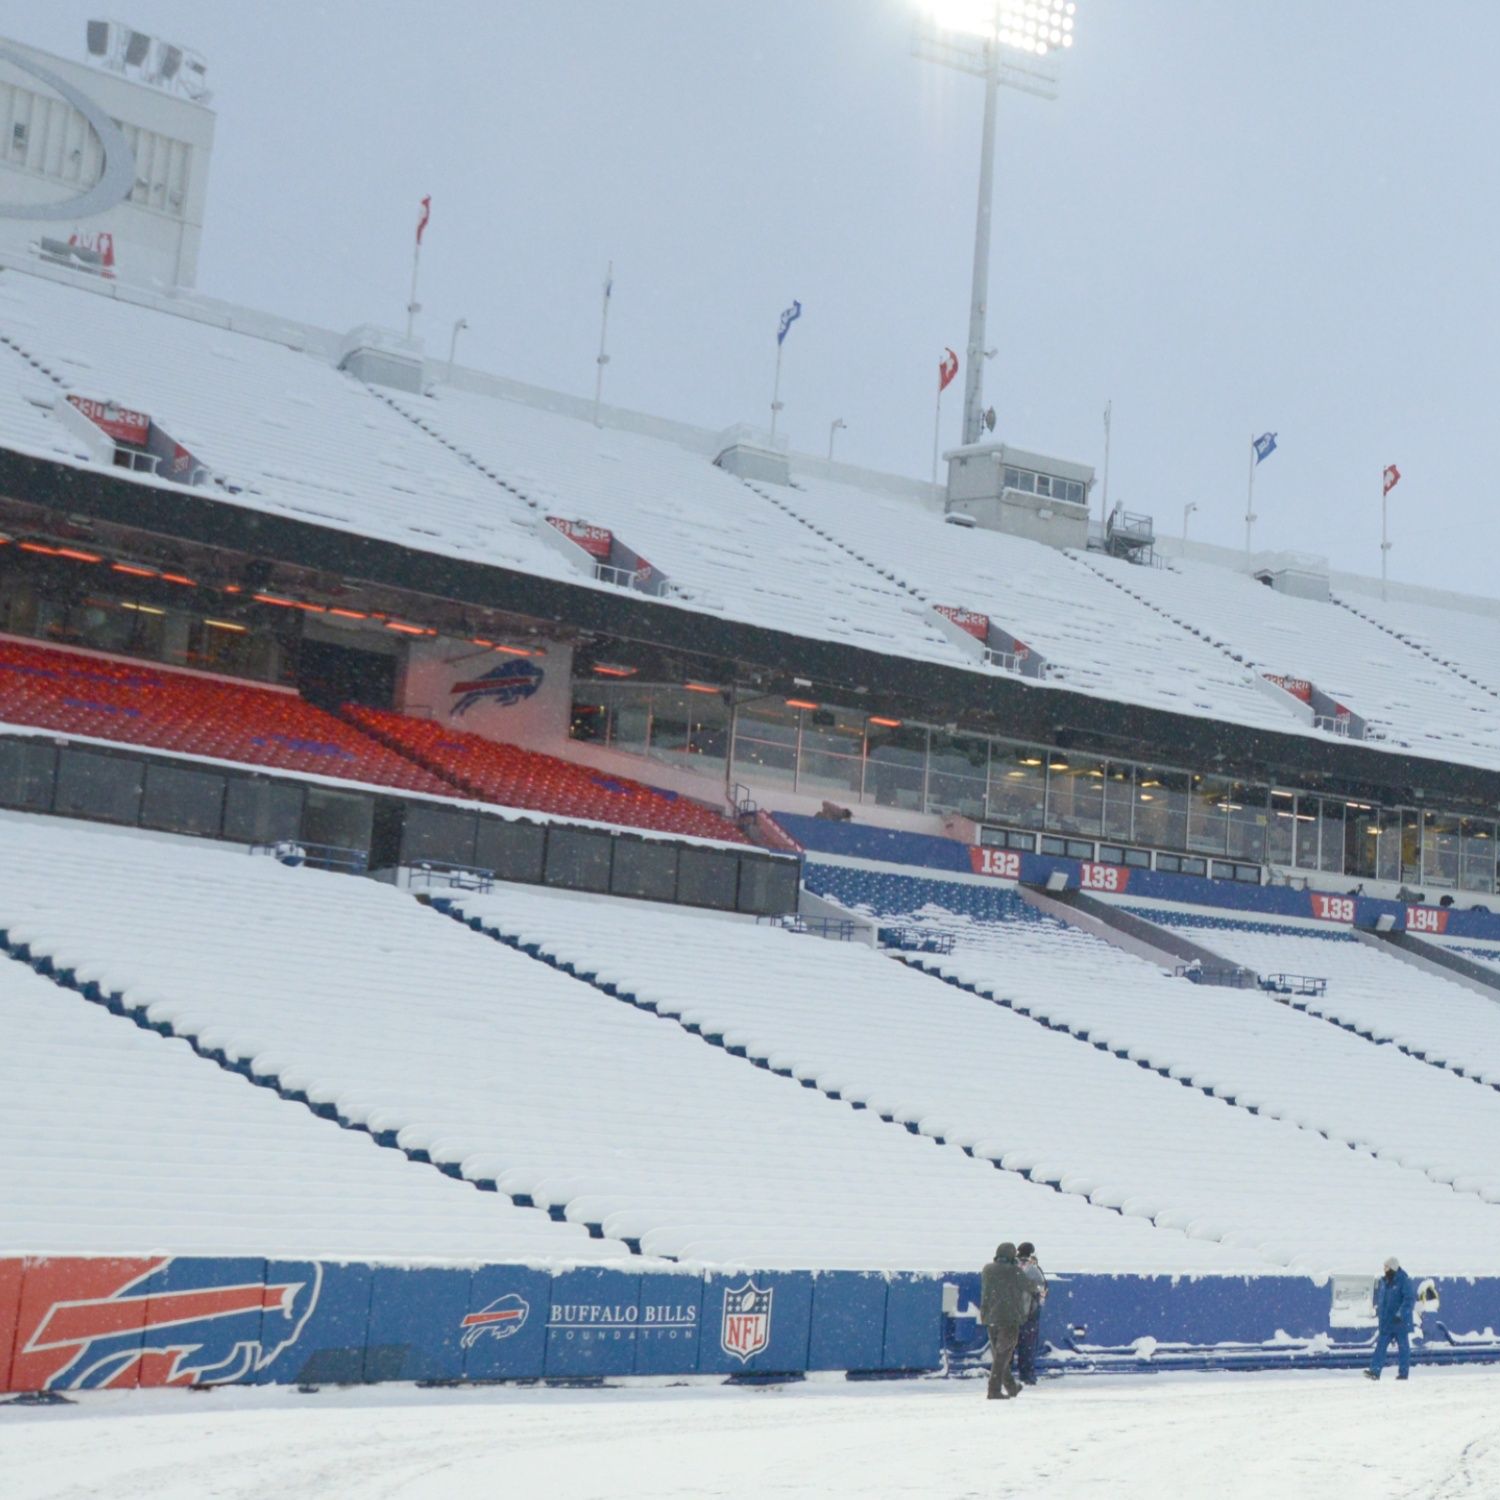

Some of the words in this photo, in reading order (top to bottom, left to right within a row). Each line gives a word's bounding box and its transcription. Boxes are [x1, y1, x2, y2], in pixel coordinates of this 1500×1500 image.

[981, 849, 1020, 877] 132
[1081, 863, 1118, 890] 133
[1320, 896, 1354, 921] 133
[1407, 908, 1438, 931] 134
[551, 1304, 638, 1322] BUFFALO
[645, 1304, 696, 1322] BILLS
[551, 1330, 693, 1341] FOUNDATION
[727, 1315, 763, 1350] NFL
